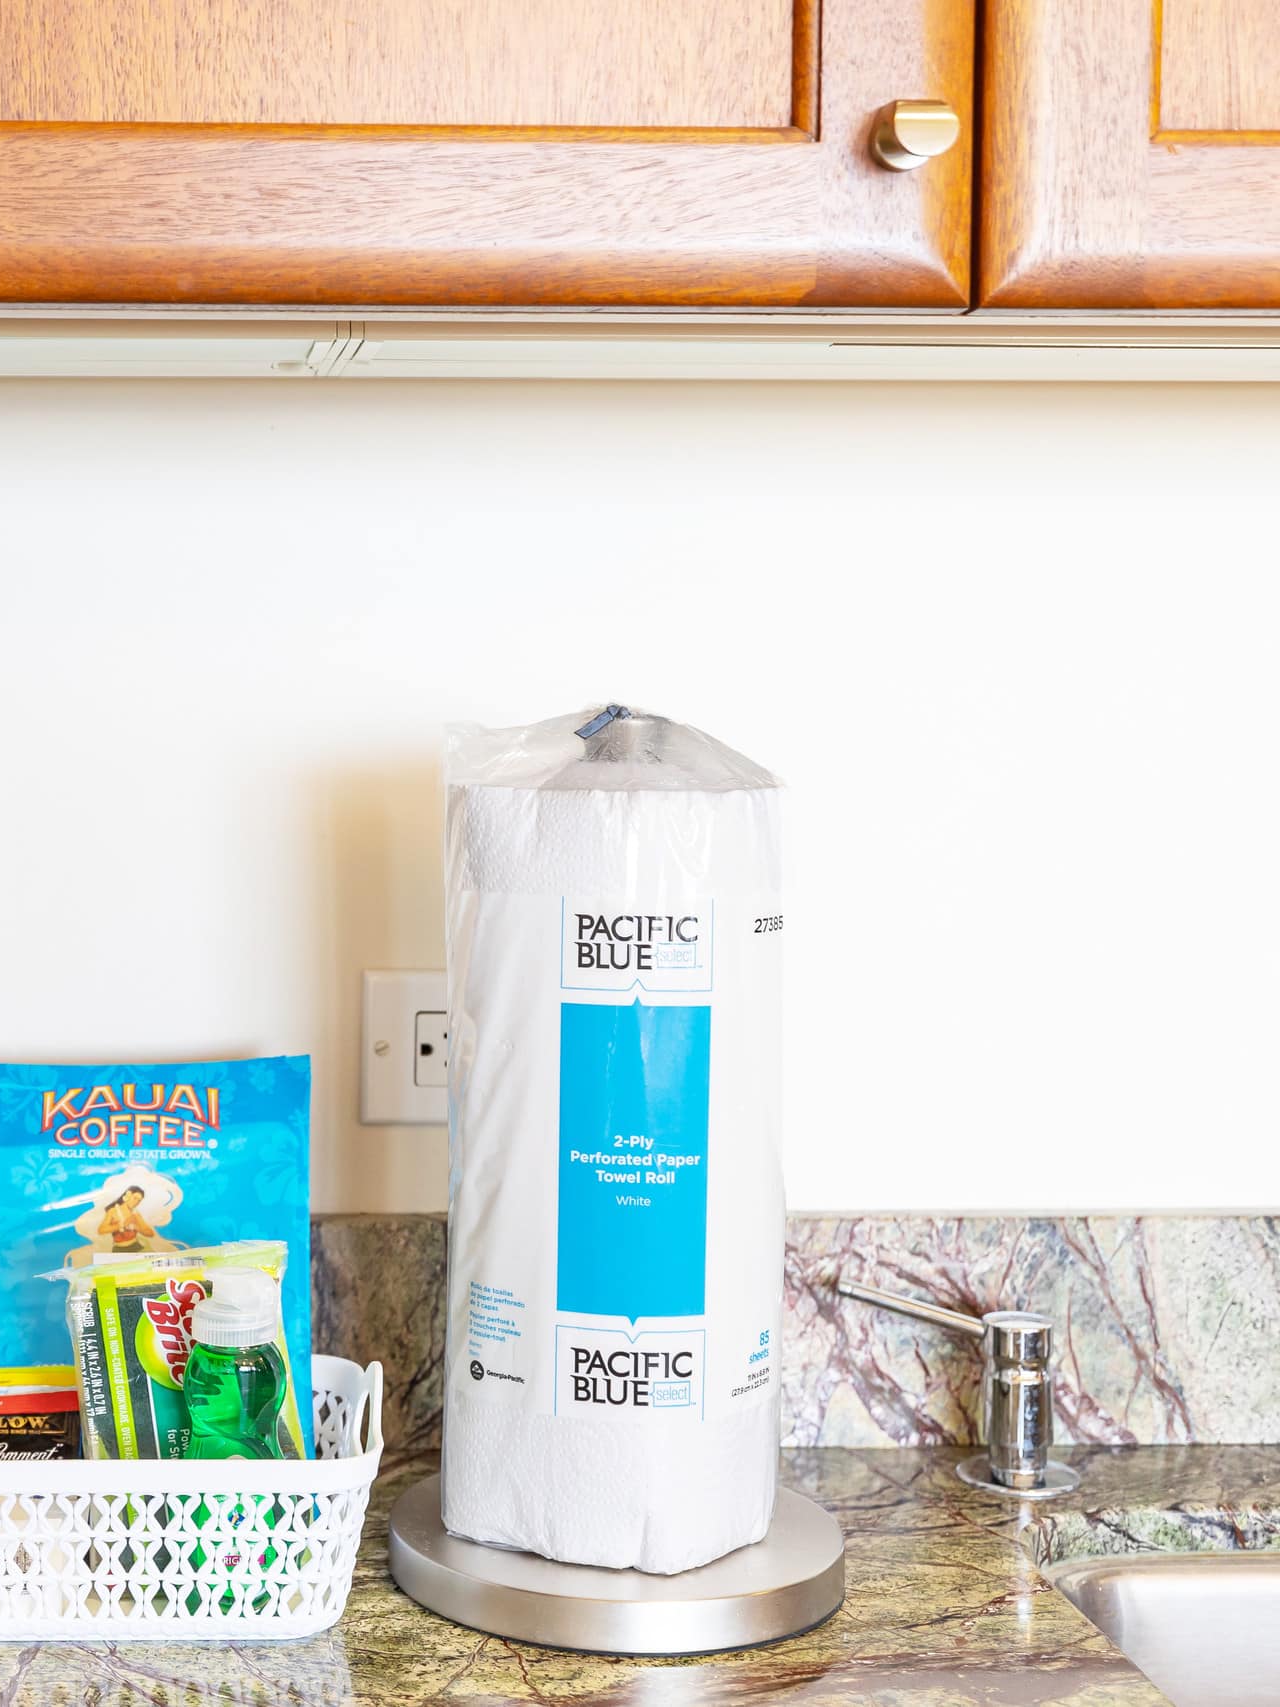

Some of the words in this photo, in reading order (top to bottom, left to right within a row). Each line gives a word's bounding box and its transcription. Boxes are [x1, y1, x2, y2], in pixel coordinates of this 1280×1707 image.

[574, 914, 698, 942] PACIFIC
[754, 915, 784, 933] 27385
[574, 942, 652, 970] BLUE
[41, 1083, 220, 1132] KAUAI
[613, 1135, 654, 1150] 2-Ply
[48, 1149, 85, 1158] SINGLE
[129, 1149, 166, 1159] ESTATE
[570, 1150, 652, 1166] Perforated
[656, 1153, 701, 1168] Paper
[595, 1169, 641, 1184] Towel
[645, 1171, 676, 1184] Roll
[616, 1195, 652, 1207] White
[84, 1303, 95, 1327] SCRUB
[105, 1308, 117, 1327] SAFE
[146, 1301, 187, 1386] Brite
[760, 1329, 769, 1346] 85
[570, 1347, 693, 1378] PACIFIC
[570, 1375, 649, 1406] BLUE
[656, 1385, 688, 1401] select
[167, 1429, 177, 1444] for
